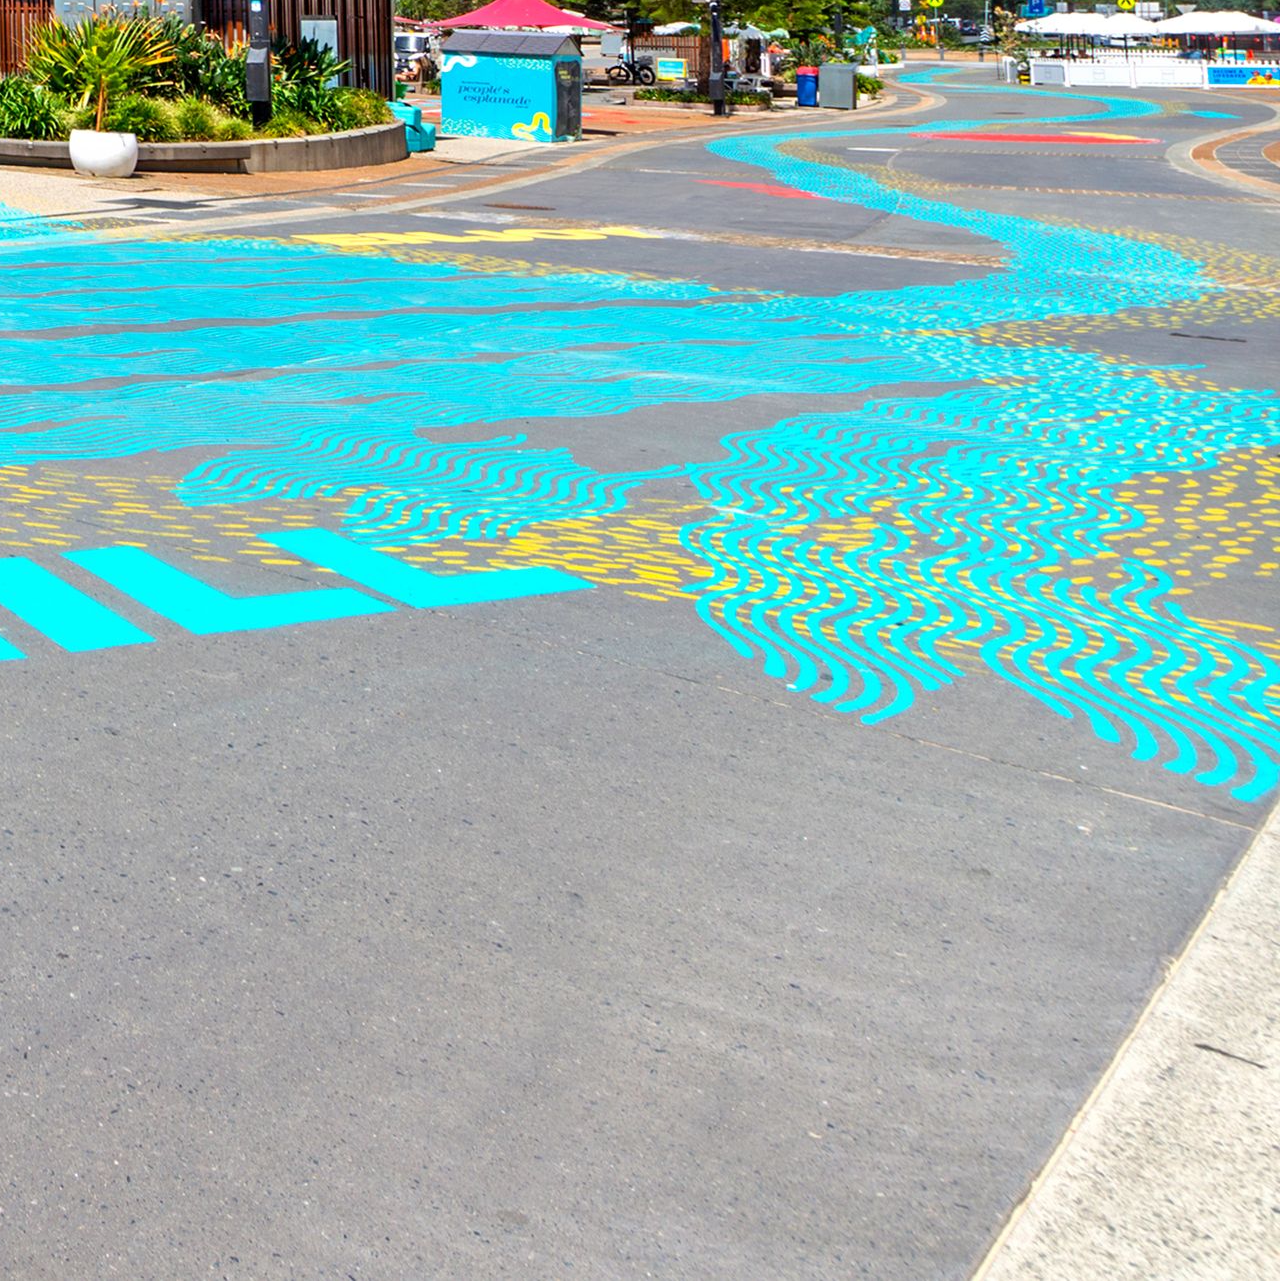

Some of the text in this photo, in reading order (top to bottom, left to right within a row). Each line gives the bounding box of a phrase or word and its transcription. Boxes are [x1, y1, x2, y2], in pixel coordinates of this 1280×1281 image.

[457, 85, 510, 95] people's
[464, 94, 531, 104] esplanade
[291, 226, 663, 246] ENJOY
